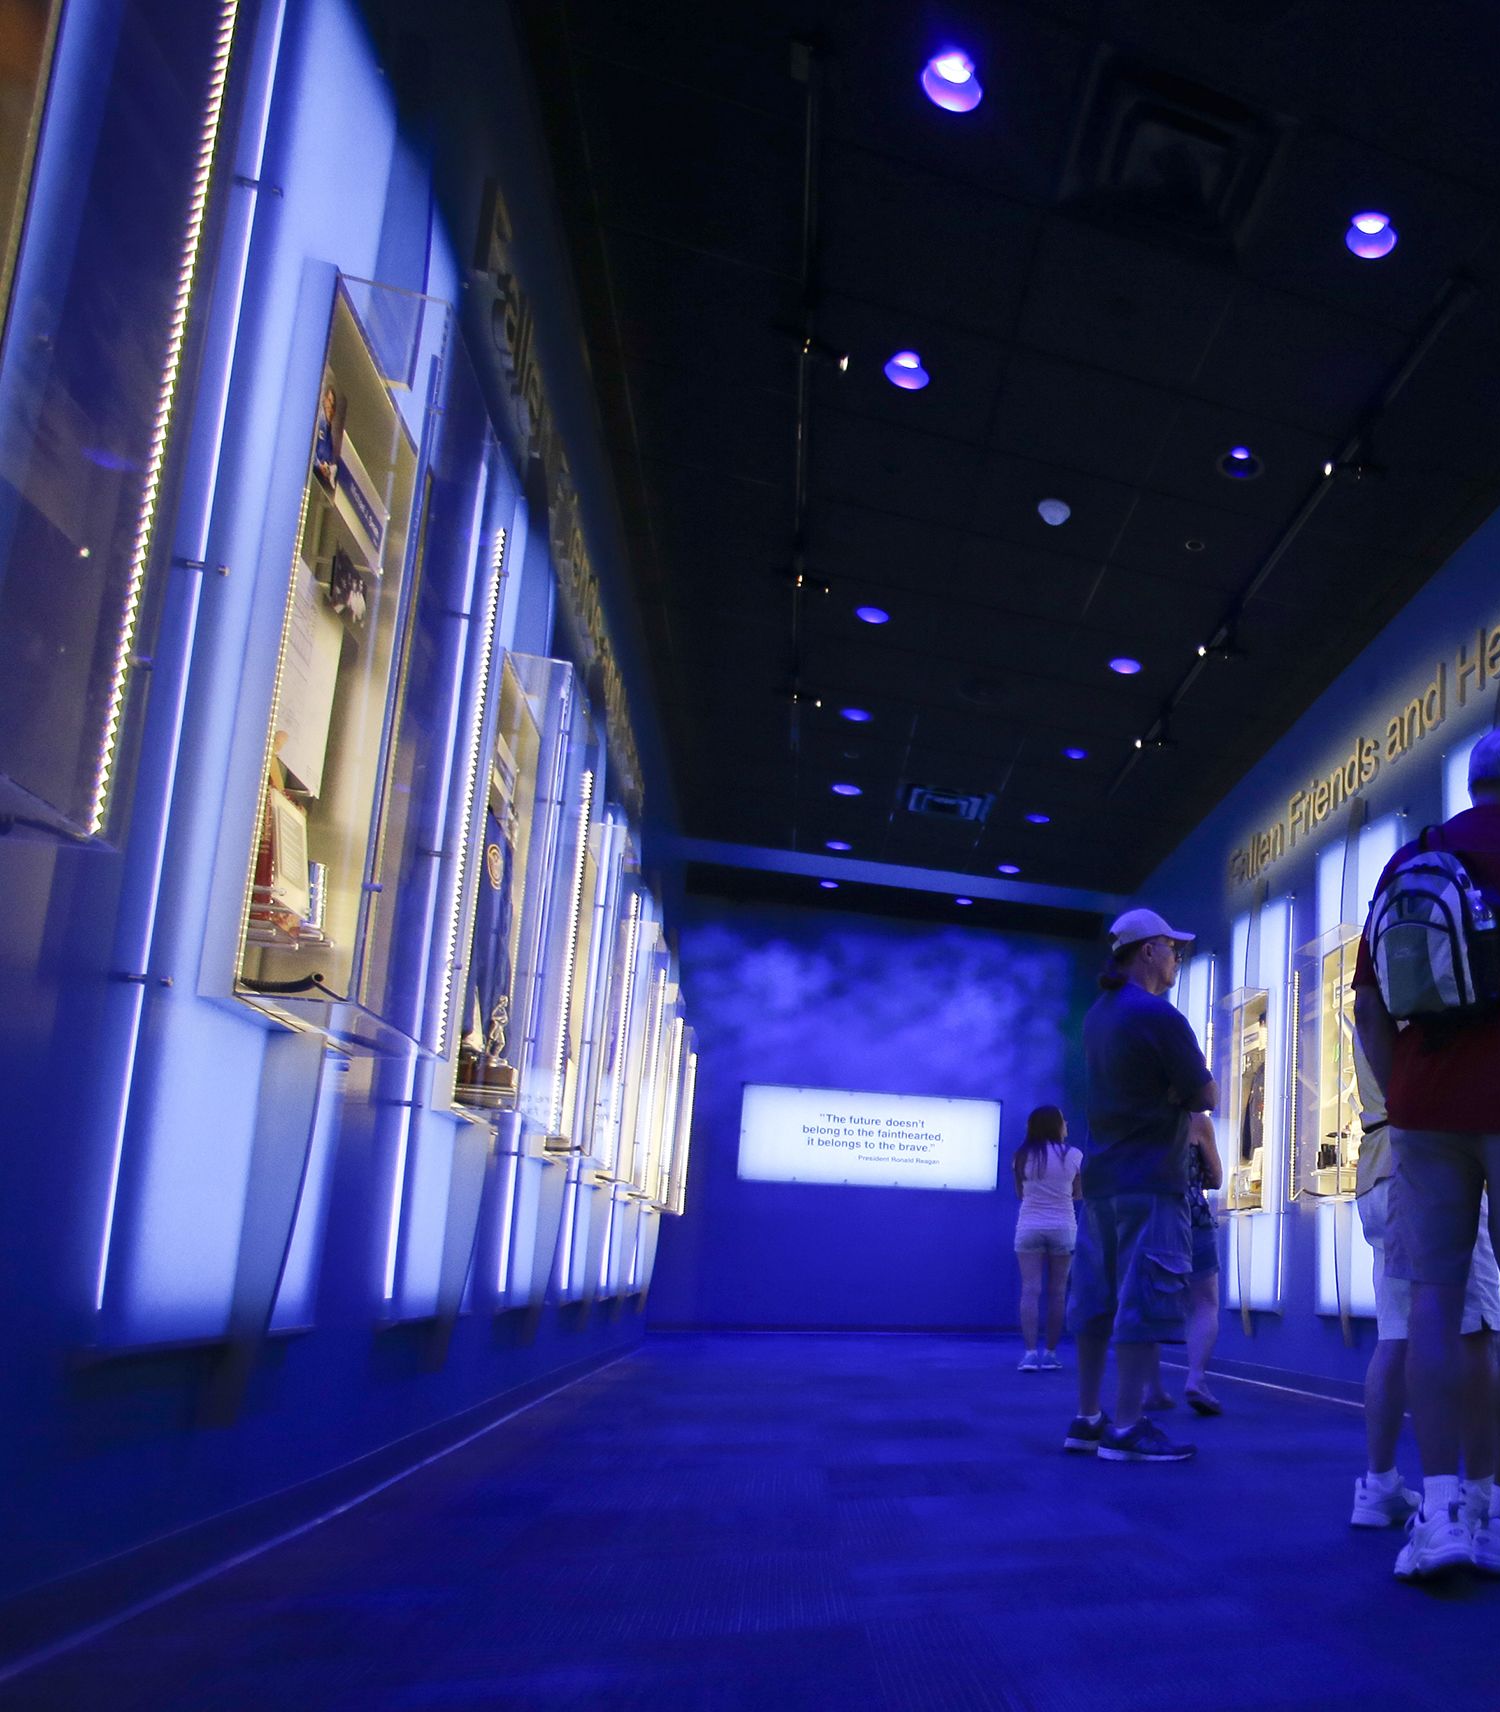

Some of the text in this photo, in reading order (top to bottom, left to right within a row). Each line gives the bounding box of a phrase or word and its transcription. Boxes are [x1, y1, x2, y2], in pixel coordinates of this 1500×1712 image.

[1228, 822, 1285, 888] Fallen
[1286, 736, 1380, 848] Friends
[1384, 661, 1447, 764] and
[849, 1115, 882, 1126] future
[885, 1117, 925, 1129] doesn't
[802, 1124, 945, 1143] belong to the fainthearted,
[806, 1136, 815, 1146] it
[817, 1137, 862, 1151] belongs
[864, 1140, 876, 1150] to
[878, 1141, 896, 1151] the
[857, 1154, 941, 1166] President Ronald Reagan
